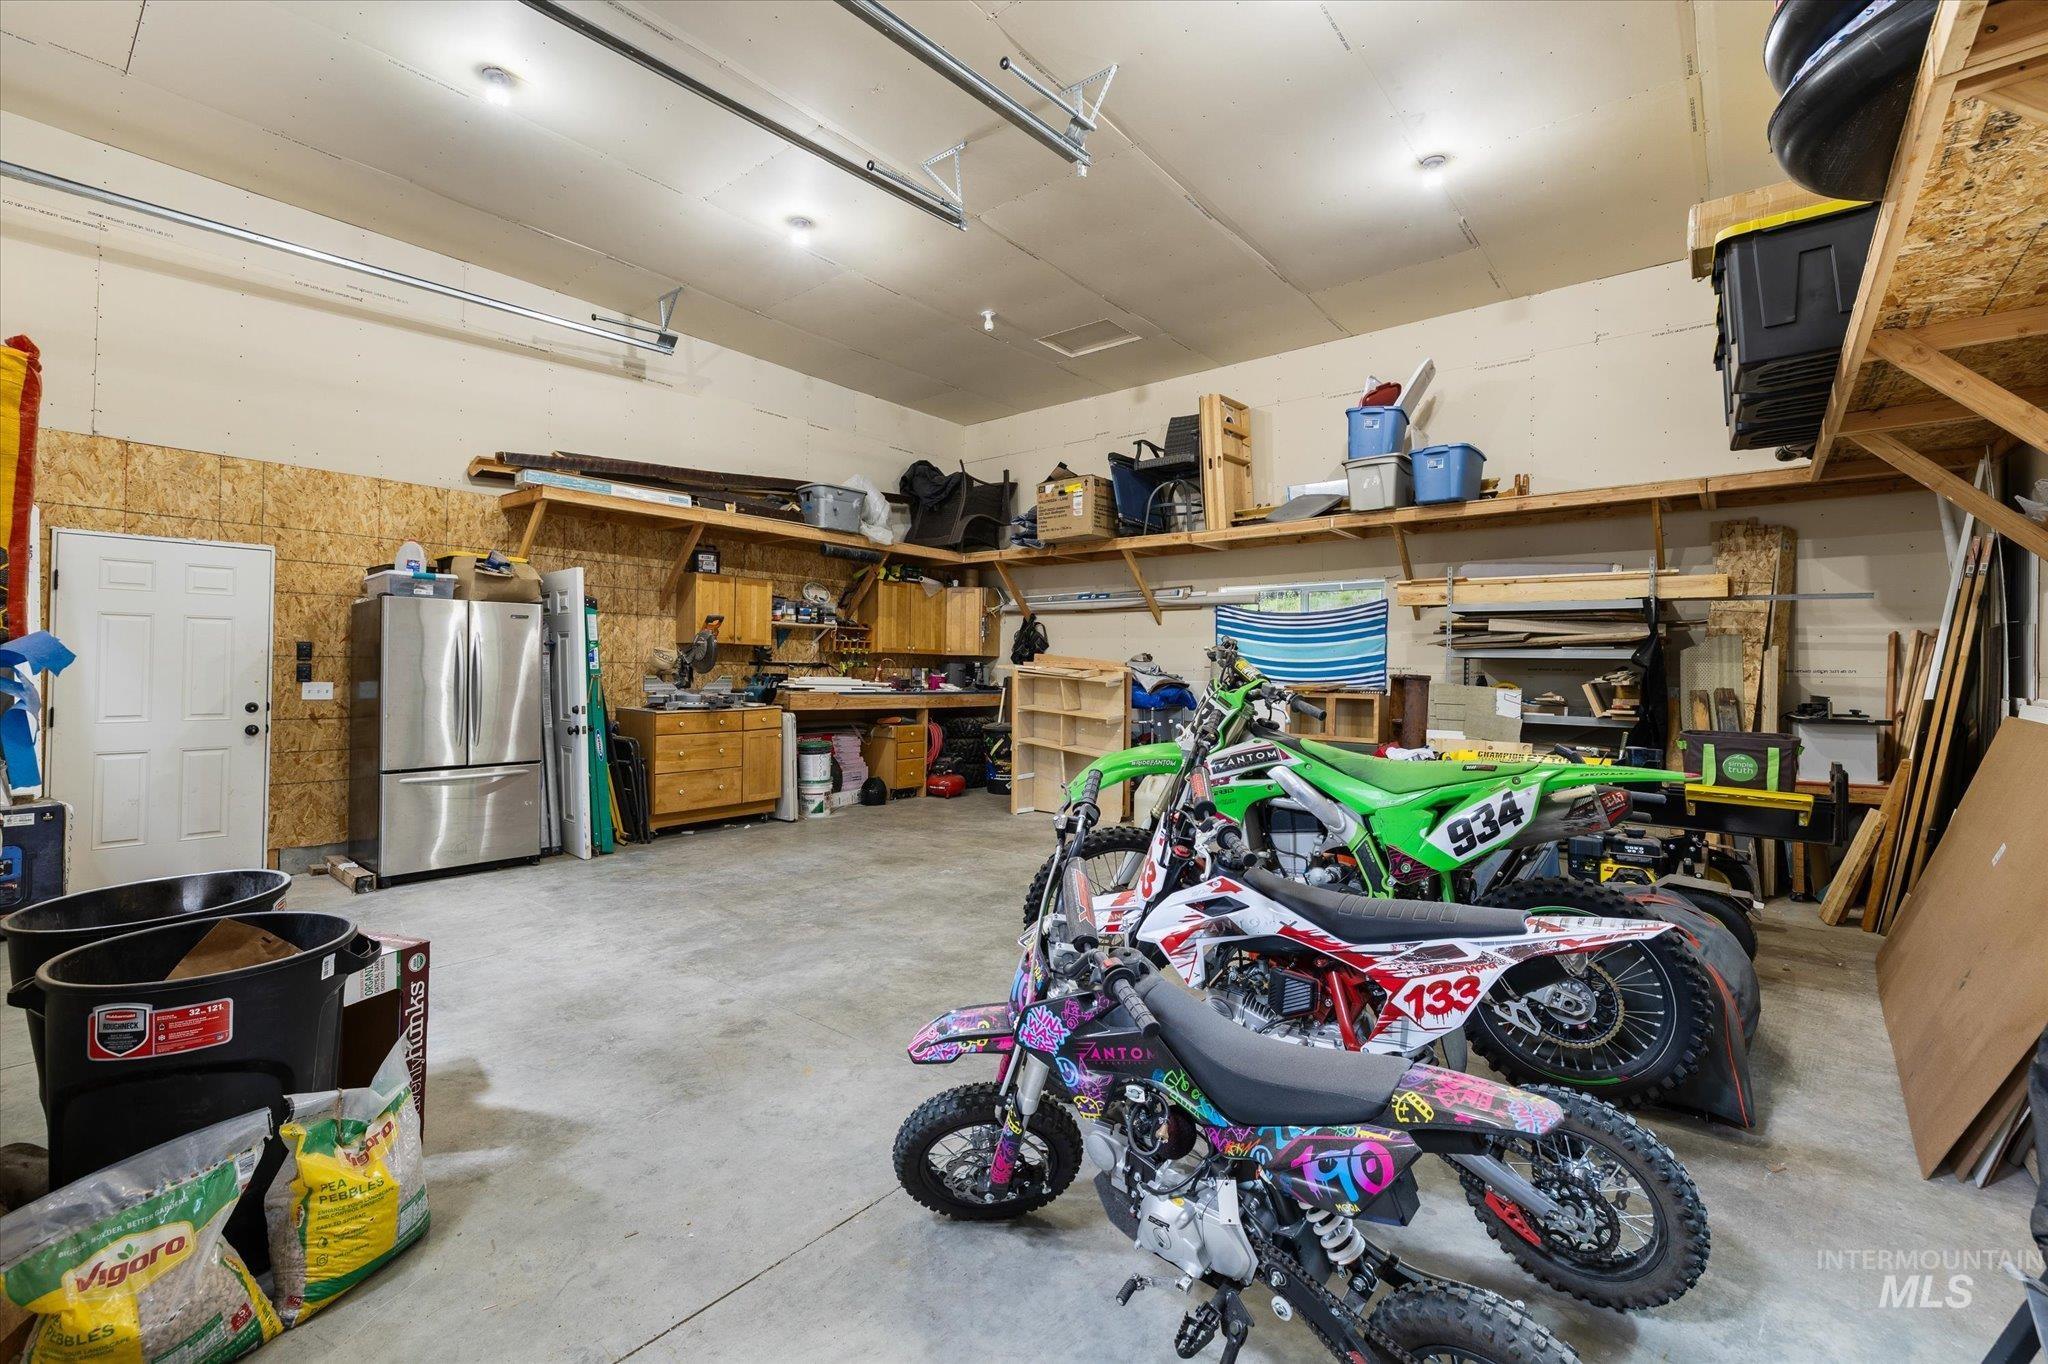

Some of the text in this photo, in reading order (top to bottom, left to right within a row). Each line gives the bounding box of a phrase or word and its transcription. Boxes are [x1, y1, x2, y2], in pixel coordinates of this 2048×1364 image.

[1477, 751, 1525, 759] CHAMPION
[1728, 760, 1754, 769] simple
[1728, 766, 1754, 774] truth
[1447, 790, 1525, 857] 934
[364, 965, 374, 997] ORGANI
[1403, 975, 1481, 1023] 133
[188, 1007, 200, 1017] 32
[103, 1021, 139, 1030] ROUGHNECK
[1290, 1141, 1395, 1201] 190
[319, 1179, 385, 1205] PEBBLES
[320, 1178, 347, 1193] PEA
[75, 1236, 186, 1293] Vigoro
